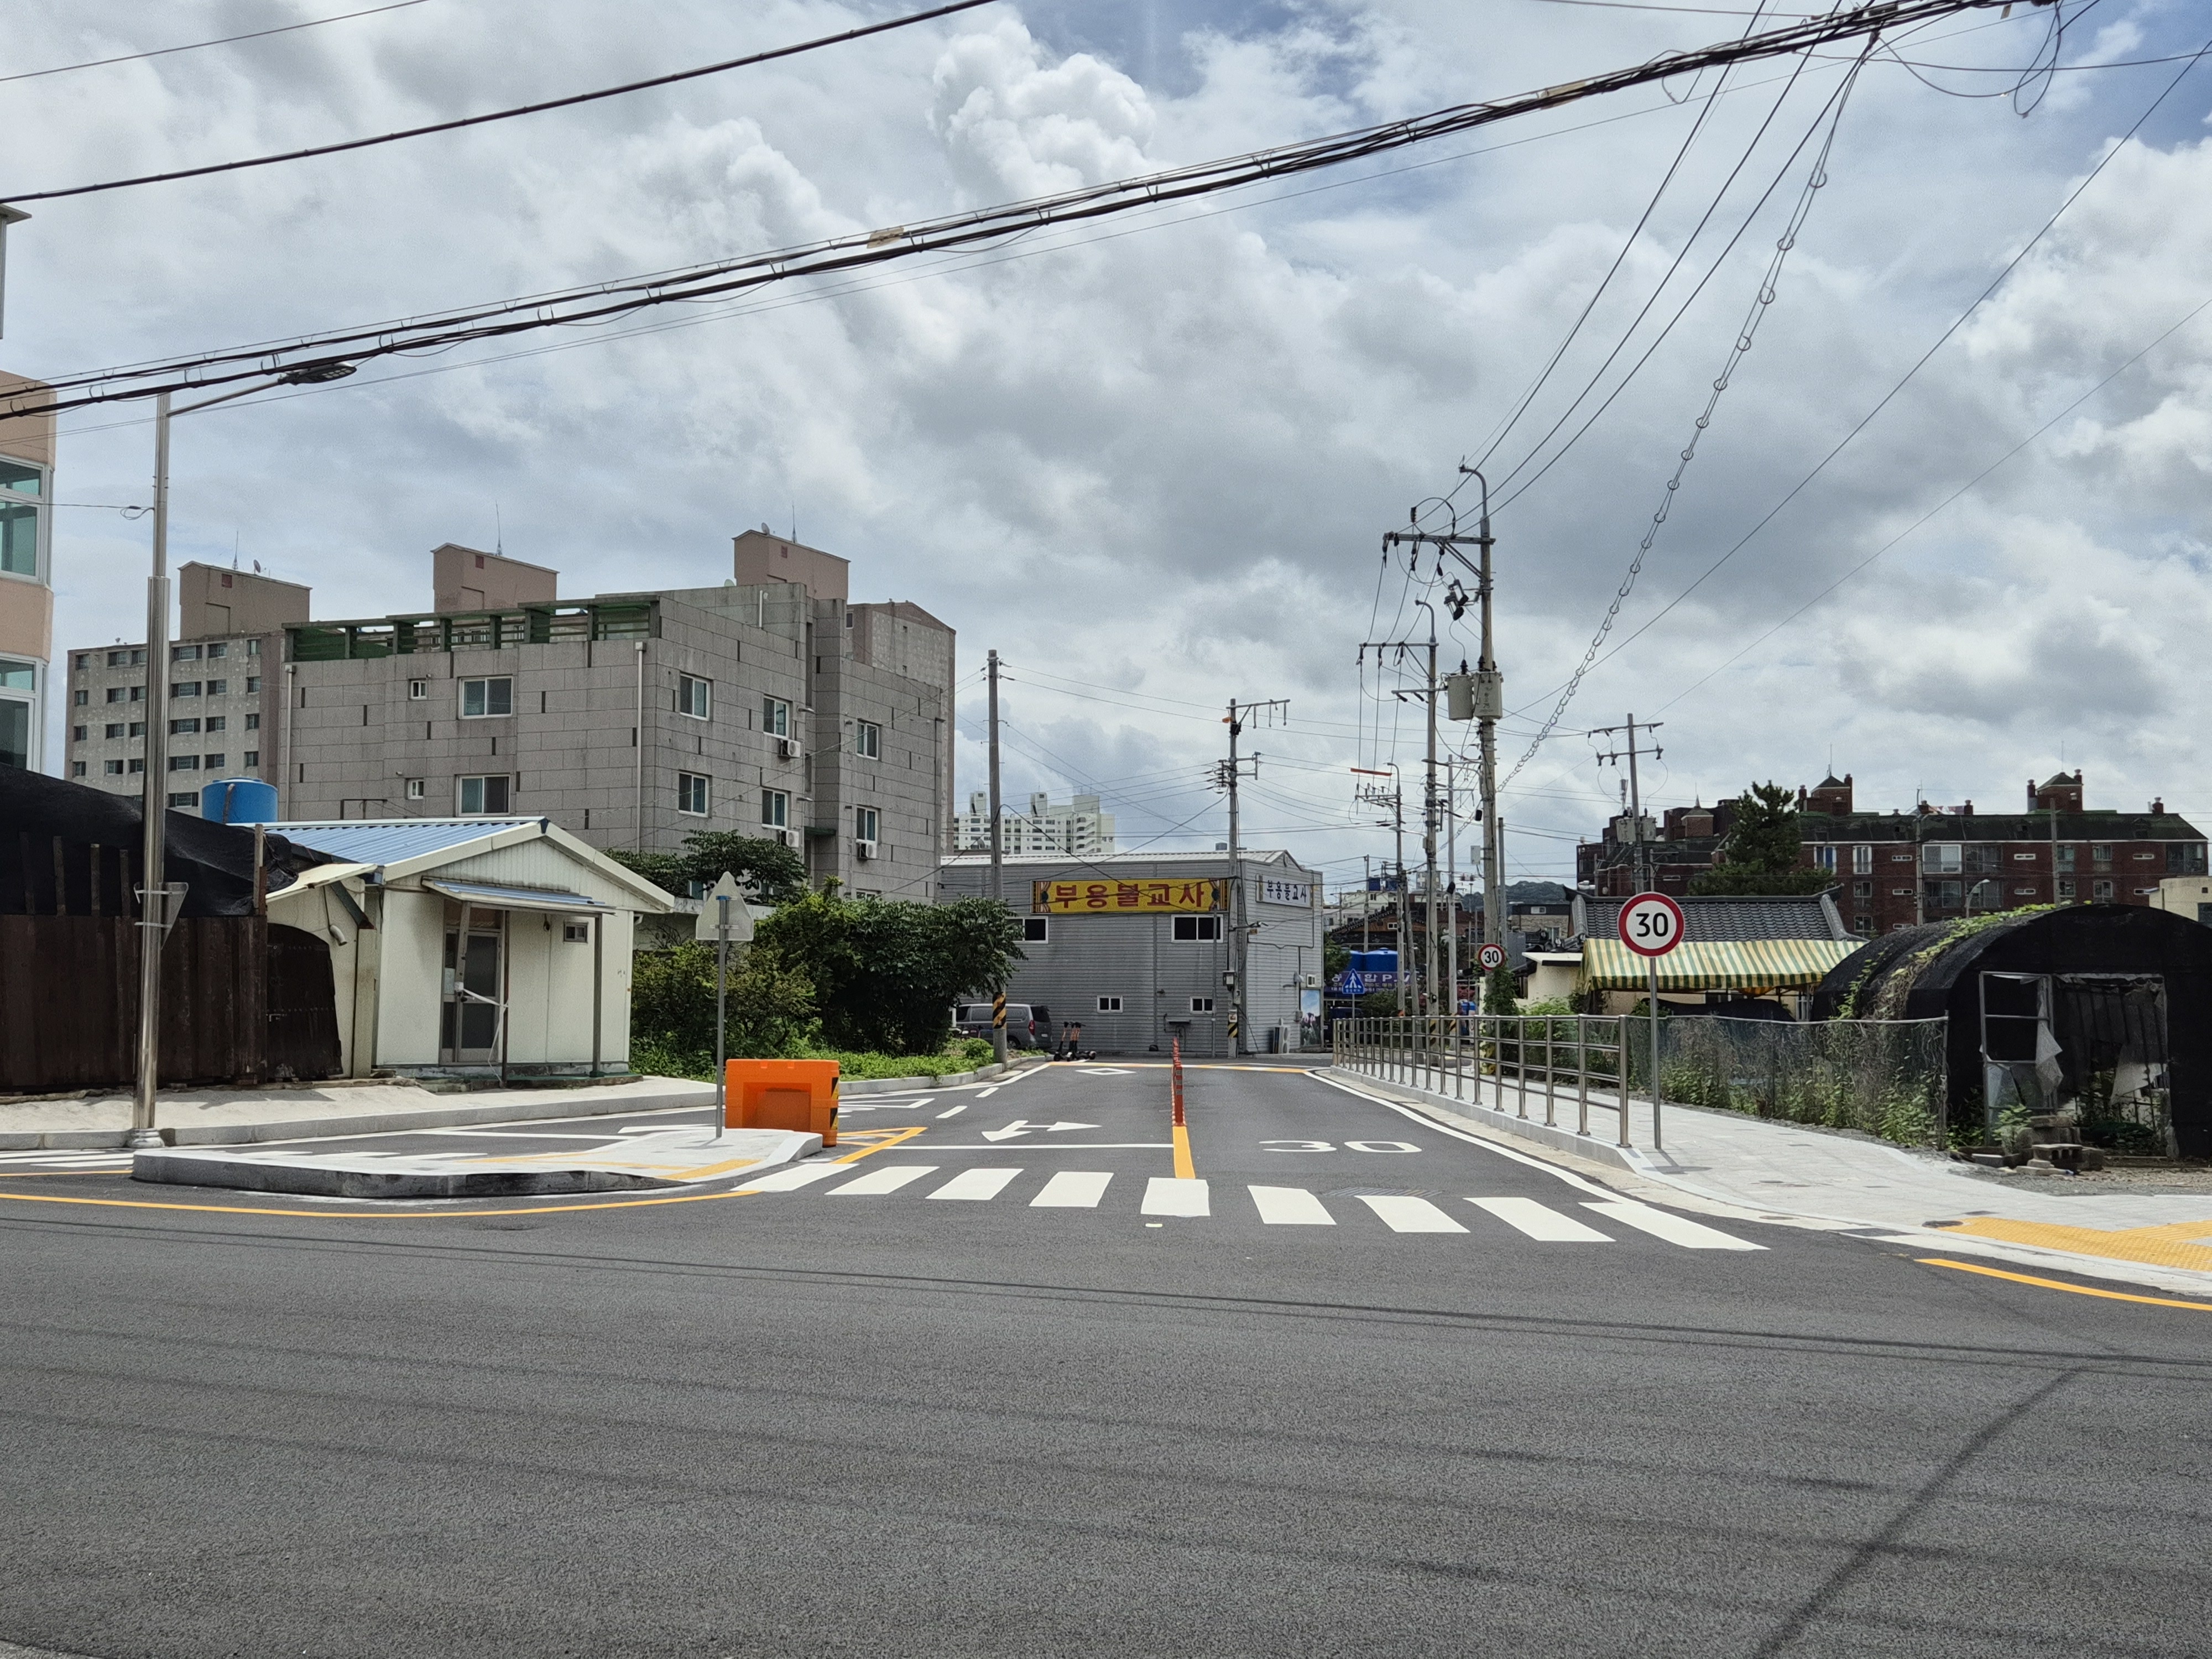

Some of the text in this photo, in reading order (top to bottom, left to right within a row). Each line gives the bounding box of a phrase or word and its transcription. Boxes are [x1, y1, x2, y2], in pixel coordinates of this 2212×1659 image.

[1055, 882, 1204, 909] 부용불교사
[1267, 879, 1307, 903] 부용불교사
[1636, 912, 1668, 937] 30
[1484, 951, 1499, 963] 30
[1259, 1140, 1422, 1153] 30
